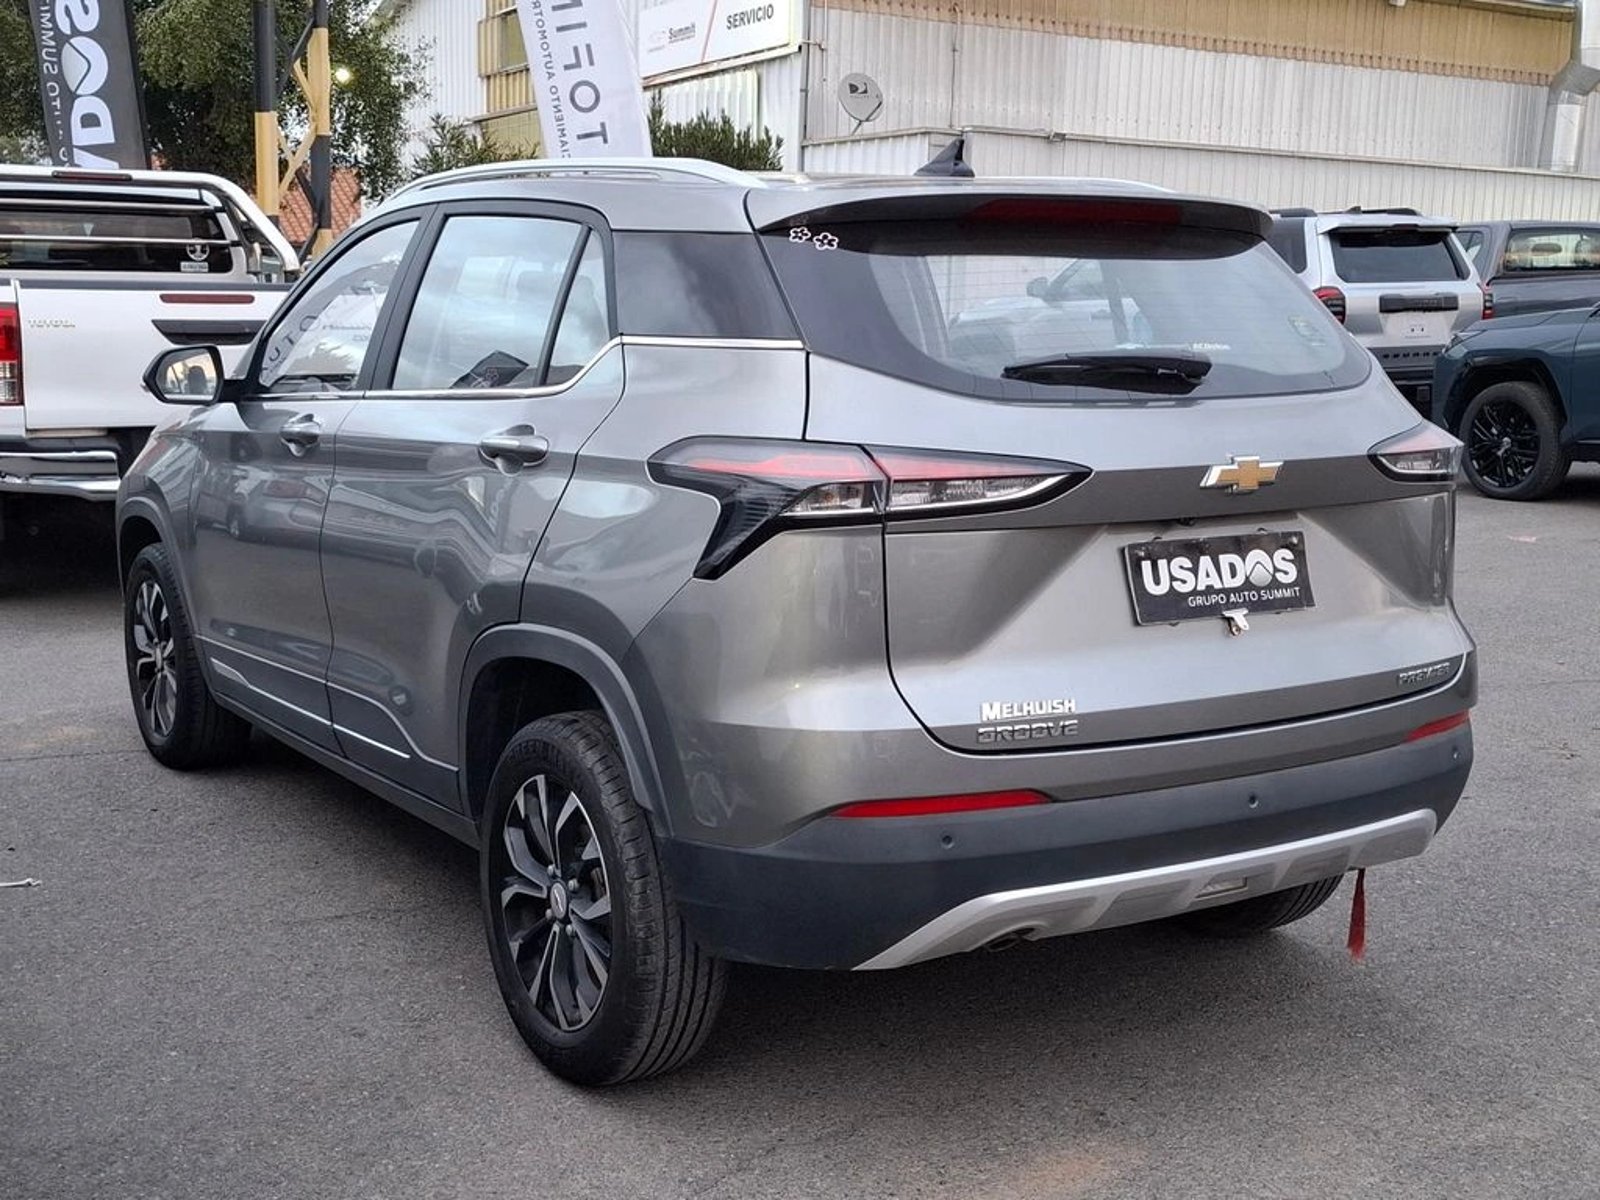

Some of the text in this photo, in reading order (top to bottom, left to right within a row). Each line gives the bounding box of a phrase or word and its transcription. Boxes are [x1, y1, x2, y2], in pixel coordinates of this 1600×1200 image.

[726, 4, 774, 30] SERVICIO
[1141, 548, 1298, 596] USADOS
[1188, 587, 1301, 608] GRUPO AUTO SUMMIT
[981, 699, 1077, 721] MELHUISH
[976, 719, 1079, 742] GROOVE
